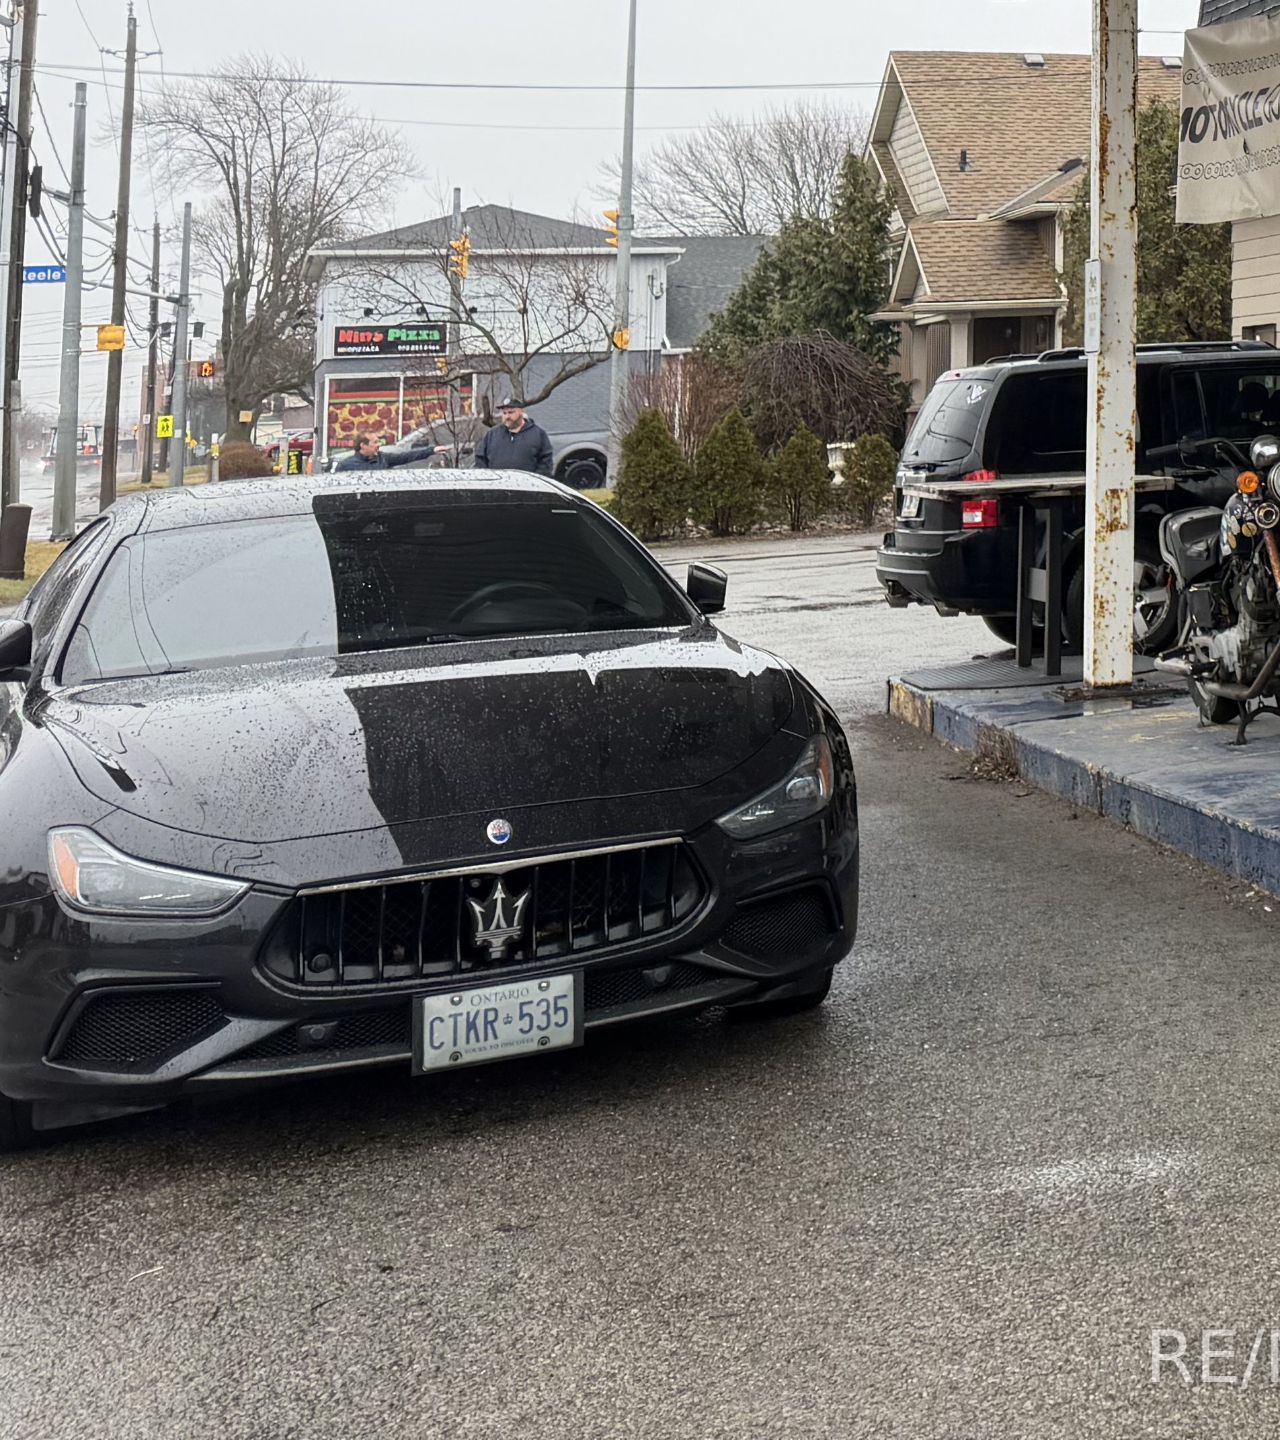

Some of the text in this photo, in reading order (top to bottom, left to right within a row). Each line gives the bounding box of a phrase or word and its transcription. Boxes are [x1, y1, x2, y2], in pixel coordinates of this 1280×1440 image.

[387, 328, 441, 341] Pizza
[470, 987, 530, 1007] ONTARIO
[429, 994, 568, 1051] CTKR 535
